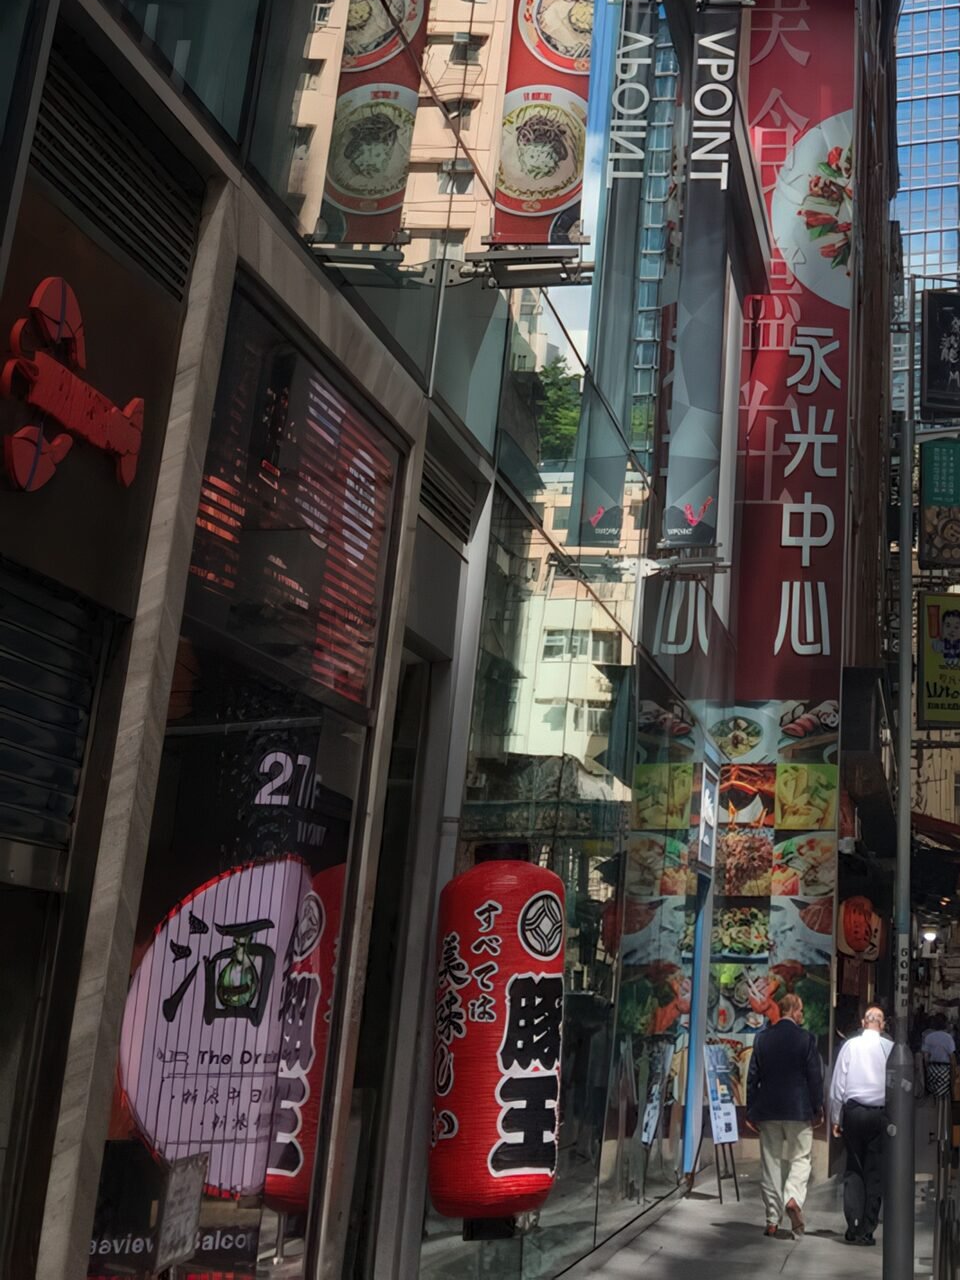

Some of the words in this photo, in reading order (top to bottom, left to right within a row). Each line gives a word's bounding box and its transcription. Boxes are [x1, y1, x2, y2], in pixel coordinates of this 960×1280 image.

[689, 28, 737, 190] VPOINT
[773, 326, 842, 656] 永光中心
[467, 899, 502, 1024] すべては
